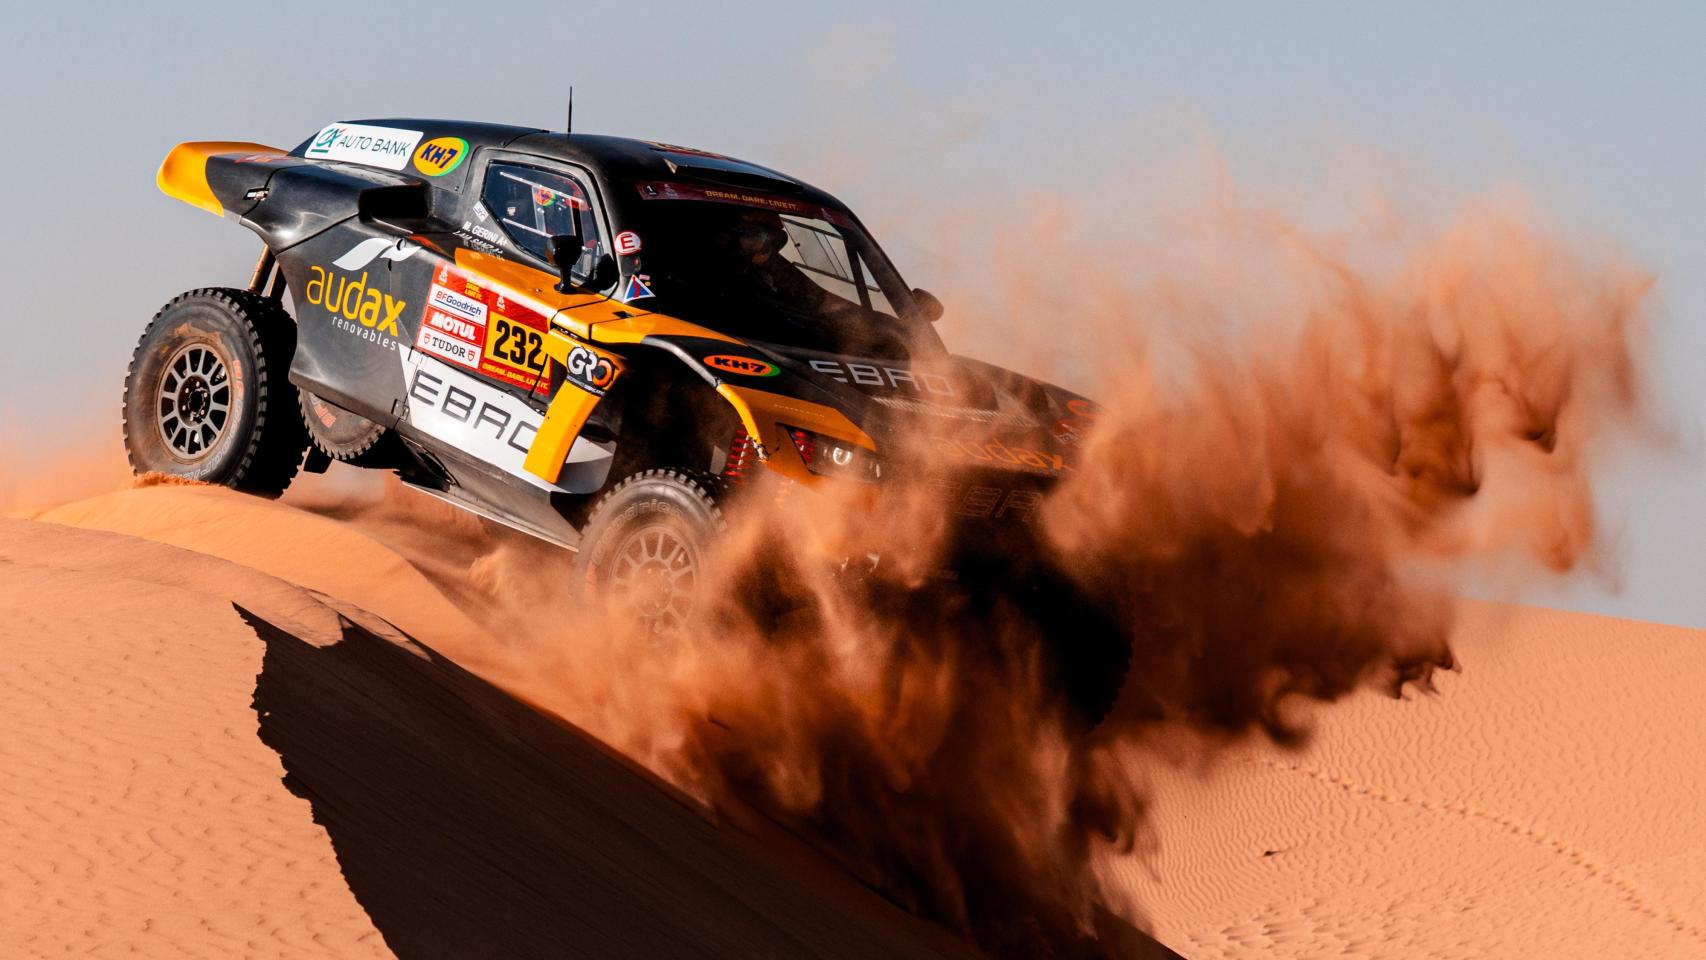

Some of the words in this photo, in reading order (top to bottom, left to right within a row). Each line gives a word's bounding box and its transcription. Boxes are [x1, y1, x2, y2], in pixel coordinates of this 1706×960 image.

[337, 135, 372, 150] AUTO
[371, 138, 412, 157] BANK
[705, 190, 740, 200] DREAM.
[742, 194, 768, 205] DARE.
[768, 199, 787, 209] LIVE
[472, 224, 500, 243] GERINI
[620, 233, 635, 250] E
[306, 265, 406, 337] audax
[435, 290, 482, 316] BFGoodrich
[331, 316, 397, 351] renovables
[430, 311, 476, 341] MOTUL
[432, 336, 466, 358] TUDOR
[492, 319, 544, 372] 232
[482, 362, 507, 376] DREAM.
[507, 370, 527, 383] DARE.
[809, 360, 954, 397] EBRO
